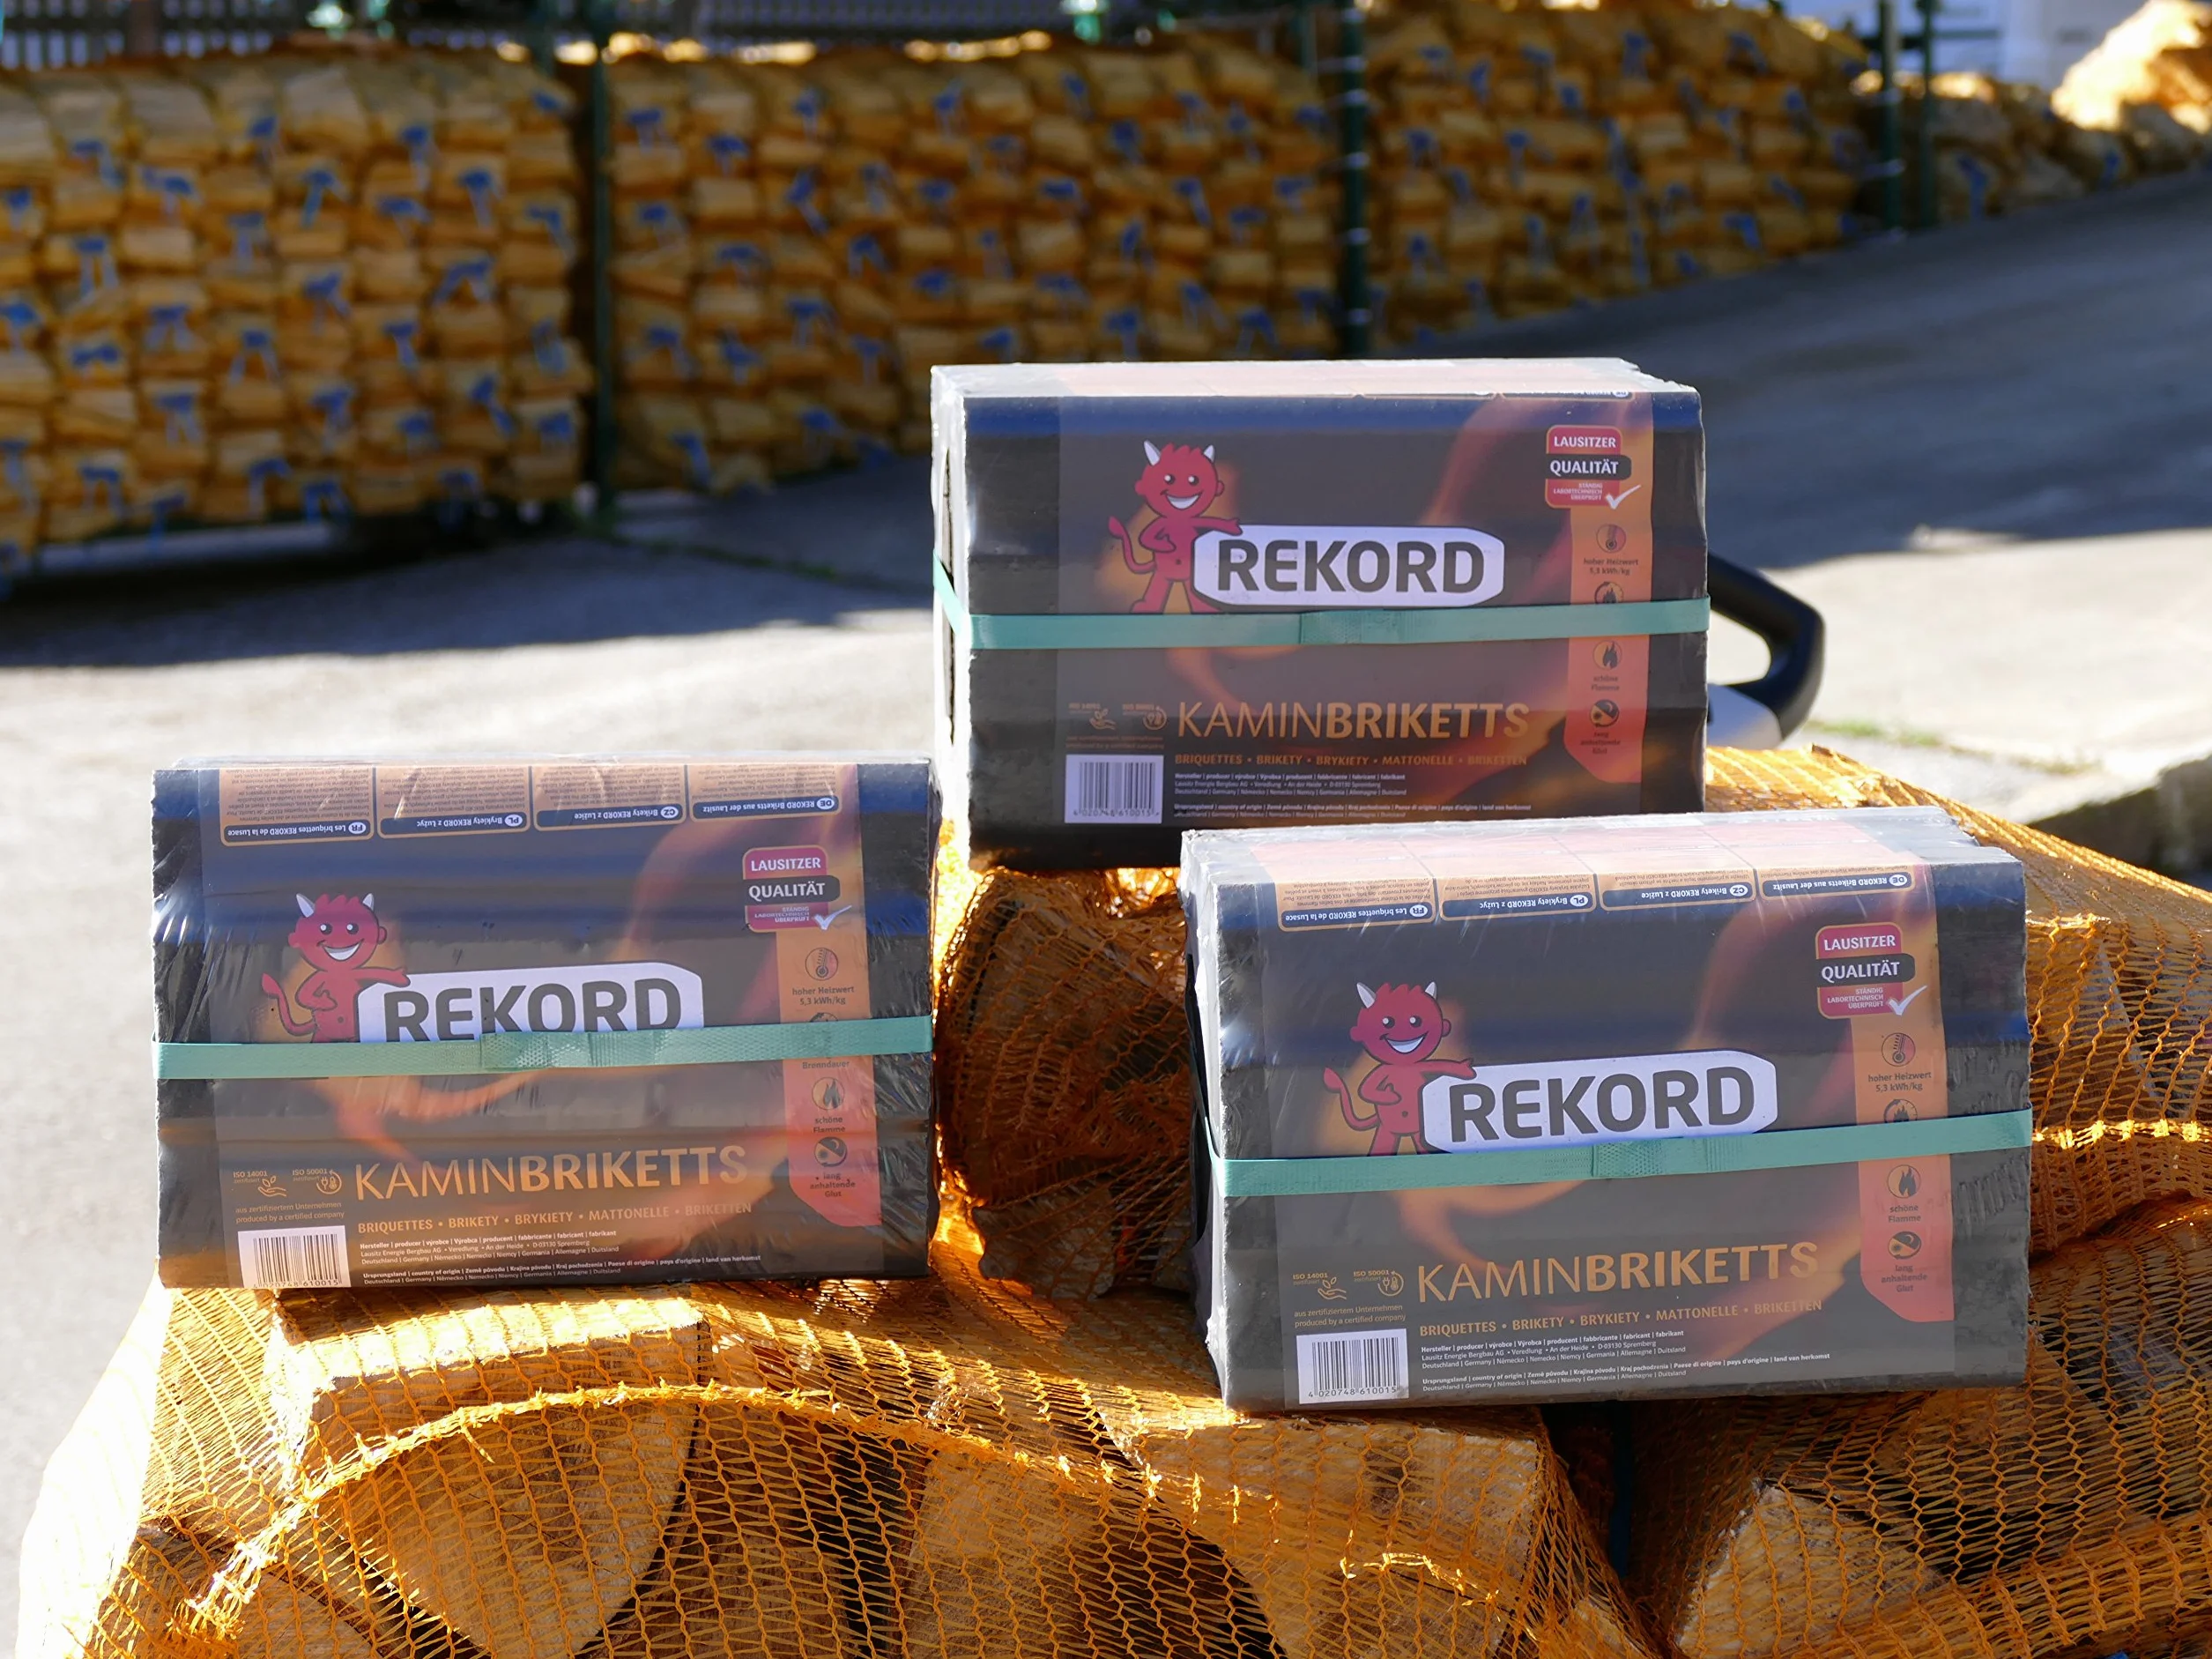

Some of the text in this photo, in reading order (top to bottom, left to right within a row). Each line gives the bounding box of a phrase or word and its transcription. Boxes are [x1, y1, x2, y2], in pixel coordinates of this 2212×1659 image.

[1554, 436, 1616, 448] LAUSITZER
[1550, 458, 1619, 477] QUALITÄT
[1218, 539, 1485, 593] REKORD
[1177, 702, 1530, 739] KAMINBRIKETTS
[1175, 754, 1243, 767] BRIQUETTES
[1256, 755, 1303, 765] BRIKETY
[1316, 755, 1369, 766] BRYKIETY
[1382, 755, 1454, 765] MATTONELLE
[633, 808, 658, 818] Brikety
[473, 816, 502, 825] Brykiety
[298, 824, 333, 834] briquettes
[751, 857, 821, 872] LAUSITZER
[1859, 877, 1887, 886] REKORD
[749, 881, 826, 902] QUALITÄT
[1701, 887, 1727, 896] Brikety
[1538, 896, 1568, 905] Brykiety
[1358, 908, 1394, 918] briquettes
[1823, 934, 1896, 951] LAUSITZER
[1821, 959, 1900, 984] QUALITÄT
[814, 997, 846, 1007] kWh/kg
[1827, 994, 1883, 1003] LABORTECHNISCH
[383, 978, 681, 1041] REKORD
[802, 1060, 850, 1069] Brenndauer
[1895, 1072, 1932, 1081] Heizwert
[1890, 1082, 1923, 1091] kWh/kg
[1449, 1066, 1755, 1142] REKORD
[355, 1146, 748, 1201] KAMINBRIKETTS
[810, 1180, 856, 1189] anhaltende
[1889, 1204, 1919, 1213] schöne
[358, 1202, 752, 1234] BRIQUETTES BRIKETY BRYKIETY MATTONELLE BRIKETTEN
[1417, 1242, 1820, 1304] KAMINBRIKETTS
[1881, 1273, 1927, 1283] anhaltende
[1308, 1307, 1354, 1316] zertifiziertem
[1355, 1305, 1403, 1313] Unternehmen
[1295, 1318, 1327, 1328] produced
[1329, 1318, 1340, 1327] by
[1344, 1315, 1373, 1324] certified
[1375, 1313, 1407, 1322] company
[1420, 1299, 1822, 1337] BRIQUETTES BRIKETY BRYKIETY MATTONELLE BRIKETTEN
[1319, 1388, 1355, 1397] 020748
[1360, 1386, 1397, 1395] 610015
